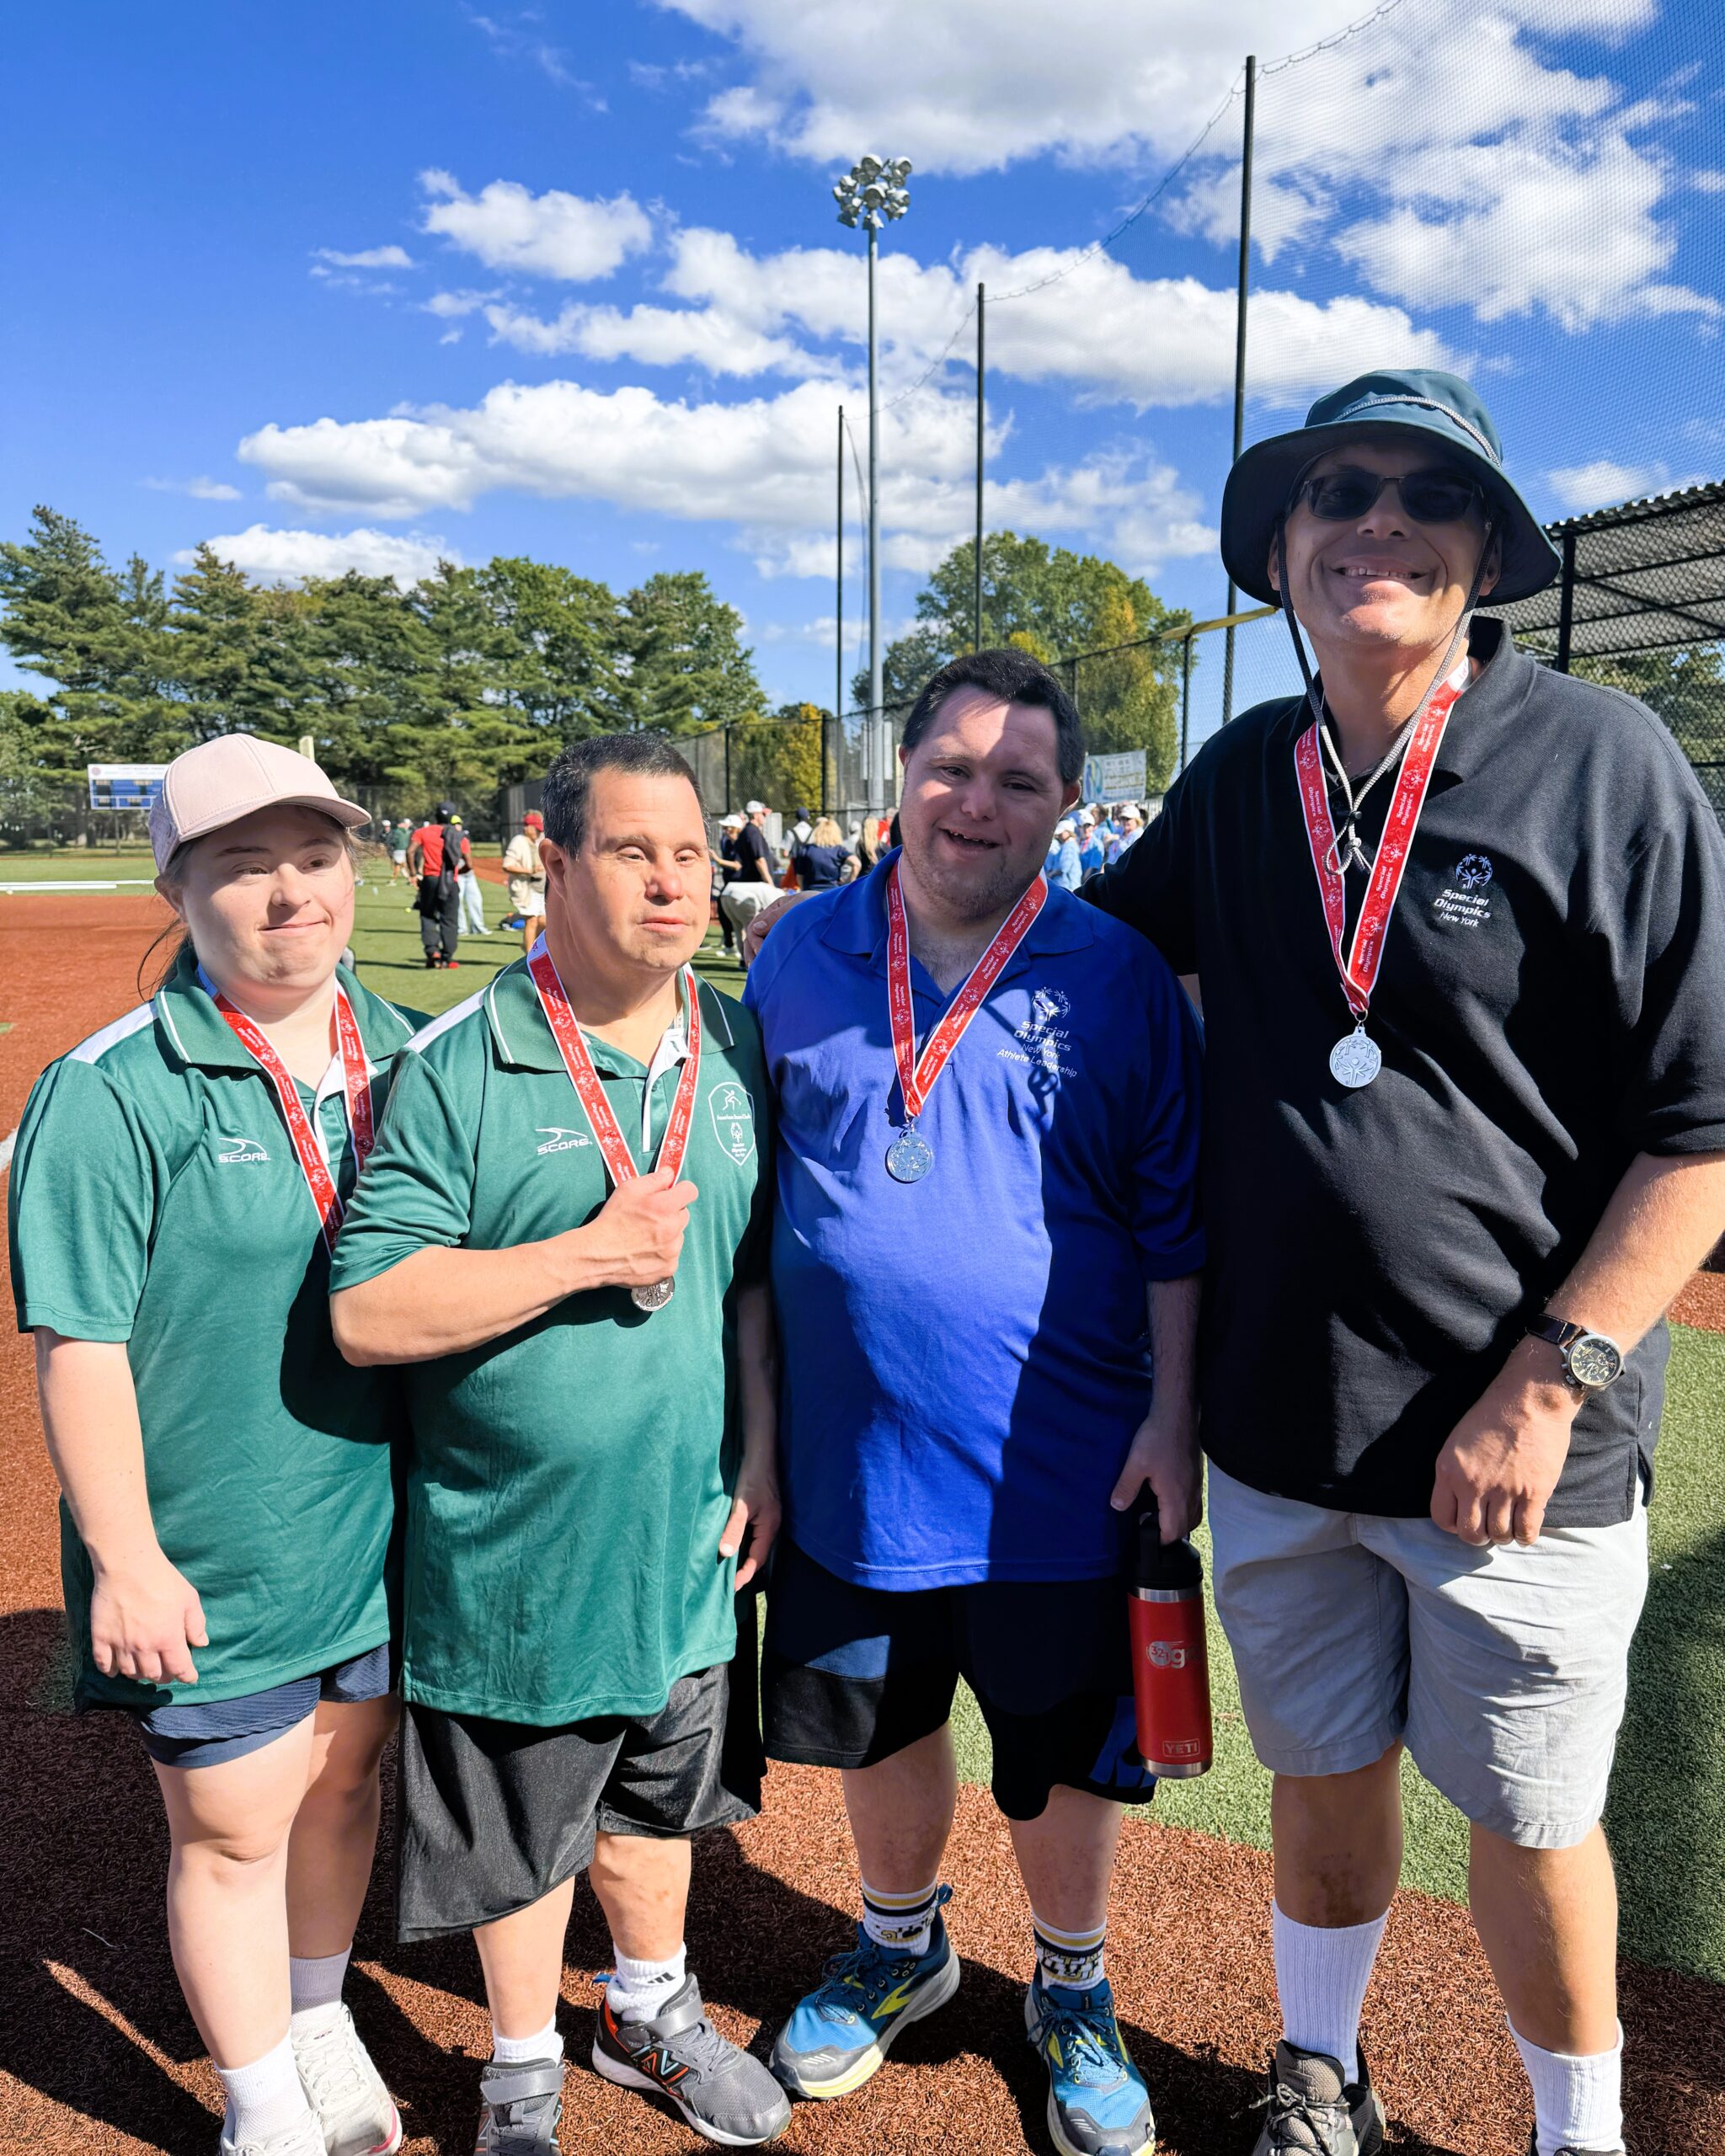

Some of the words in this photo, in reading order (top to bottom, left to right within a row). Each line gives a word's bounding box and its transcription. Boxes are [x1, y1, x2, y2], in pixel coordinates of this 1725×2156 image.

[1308, 787, 1316, 817] Olympics
[1397, 792, 1407, 819] Special
[1401, 793, 1413, 826] Olympics
[1376, 866, 1387, 892] Special
[1380, 867, 1393, 899] Olympics
[1442, 889, 1489, 906] Special
[1434, 899, 1492, 919] Olympics
[1439, 911, 1460, 922] New
[1461, 916, 1479, 927] York
[1358, 939, 1368, 965] Special
[1363, 941, 1374, 973] Olympics
[1021, 1021, 1069, 1039] Special
[1013, 1030, 1071, 1052] Olympics
[1021, 1043, 1041, 1054] New
[1042, 1048, 1060, 1059] York
[996, 1049, 1030, 1063] Athlete
[1030, 1055, 1077, 1078] Leadership
[218, 1152, 267, 1163] SCORE
[537, 1139, 590, 1155] SCORE
[1151, 1645, 1169, 1662] 321
[1165, 1742, 1198, 1754] YETI
